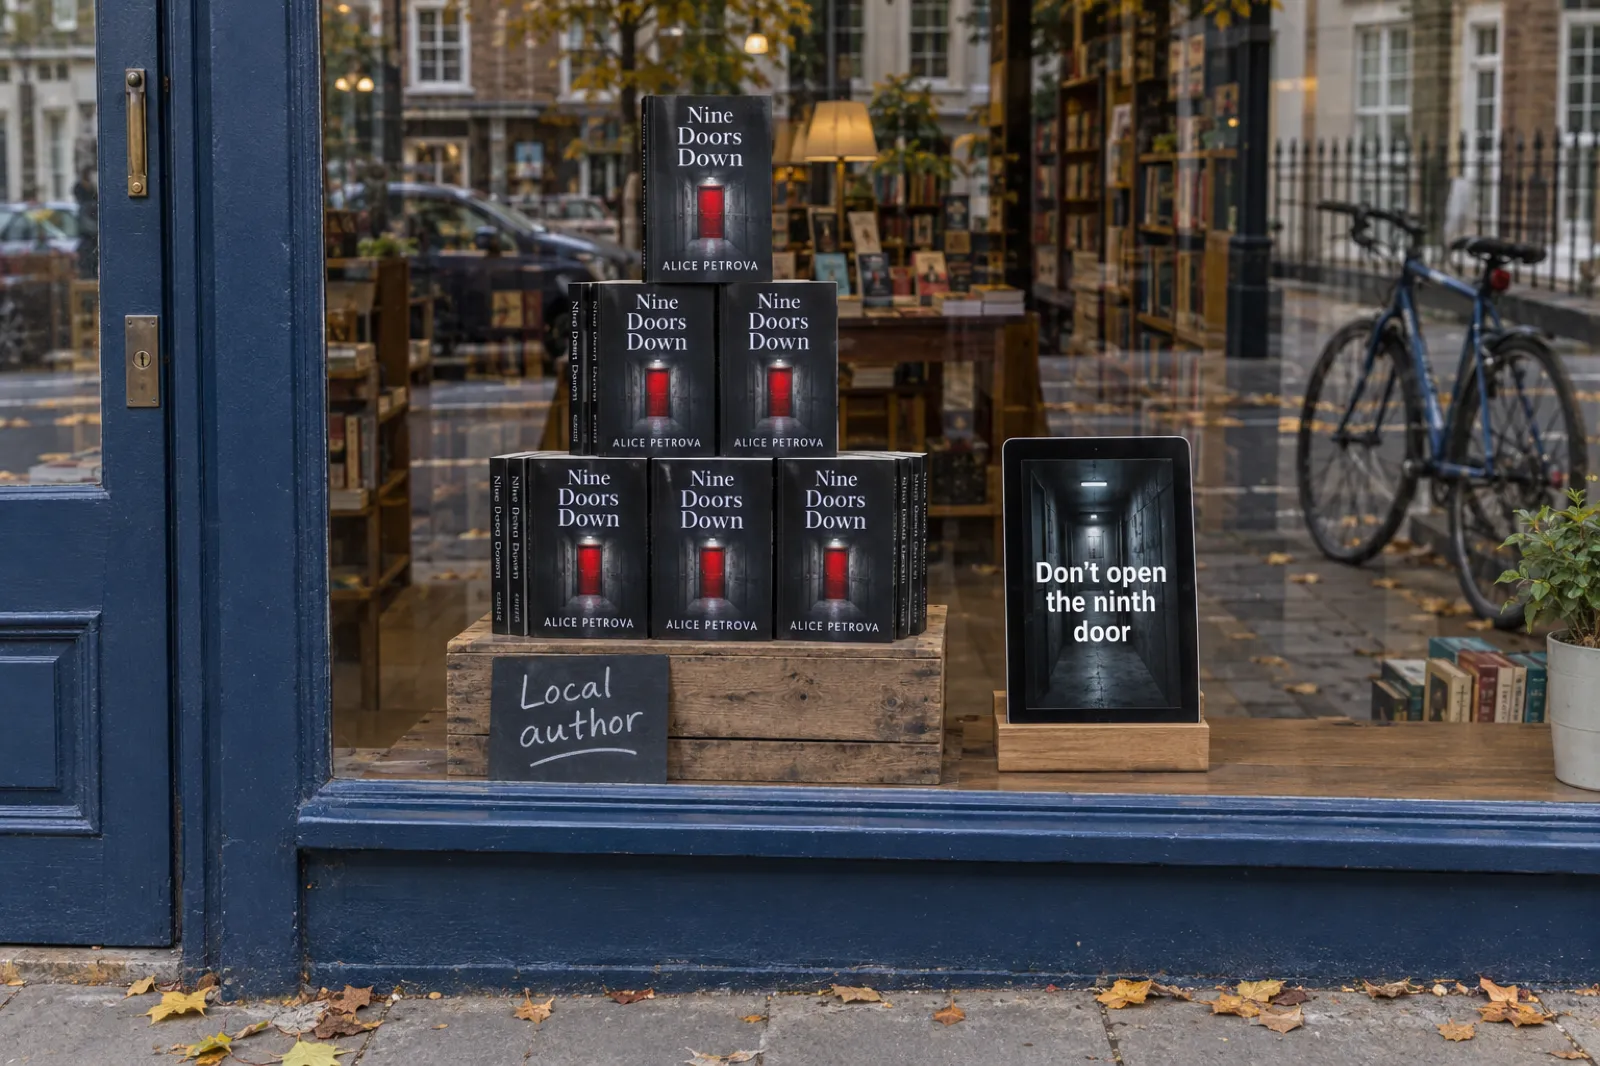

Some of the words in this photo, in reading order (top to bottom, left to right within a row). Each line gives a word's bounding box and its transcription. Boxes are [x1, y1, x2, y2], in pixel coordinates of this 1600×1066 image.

[688, 106, 733, 123] Nine
[678, 127, 742, 145] Doors
[678, 148, 743, 167] Down
[662, 260, 698, 271] ALICE
[703, 260, 758, 271] PETROVA
[636, 293, 678, 310] Nine
[757, 293, 801, 309] Nine
[626, 313, 687, 330] Doors
[749, 312, 809, 330] Doors
[626, 333, 688, 351] Down
[748, 332, 810, 350] Down
[612, 437, 646, 448] ALICE
[650, 437, 701, 448] PETROVA
[734, 438, 767, 448] ALICE
[772, 438, 824, 448] PETROVA
[568, 469, 610, 485] Nine
[690, 470, 734, 487] Nine
[815, 470, 858, 486] Nine
[558, 488, 619, 506] Doors
[681, 490, 743, 508] Doors
[805, 490, 866, 508] Doors
[558, 508, 620, 527] Down
[681, 510, 743, 529] Down
[805, 510, 867, 530] Down
[1036, 561, 1099, 583] Don’t
[1106, 564, 1167, 588] open
[1046, 590, 1086, 613] the
[1094, 590, 1156, 613] ninth
[544, 616, 578, 628] ALICE
[582, 616, 634, 628] PETROVA
[666, 619, 700, 630] ALICE
[704, 619, 758, 631] PETROVA
[790, 620, 823, 631] ALICE
[828, 621, 880, 632] PETROVA
[1073, 620, 1132, 643] door
[520, 665, 611, 711] Local
[519, 706, 644, 748] author
